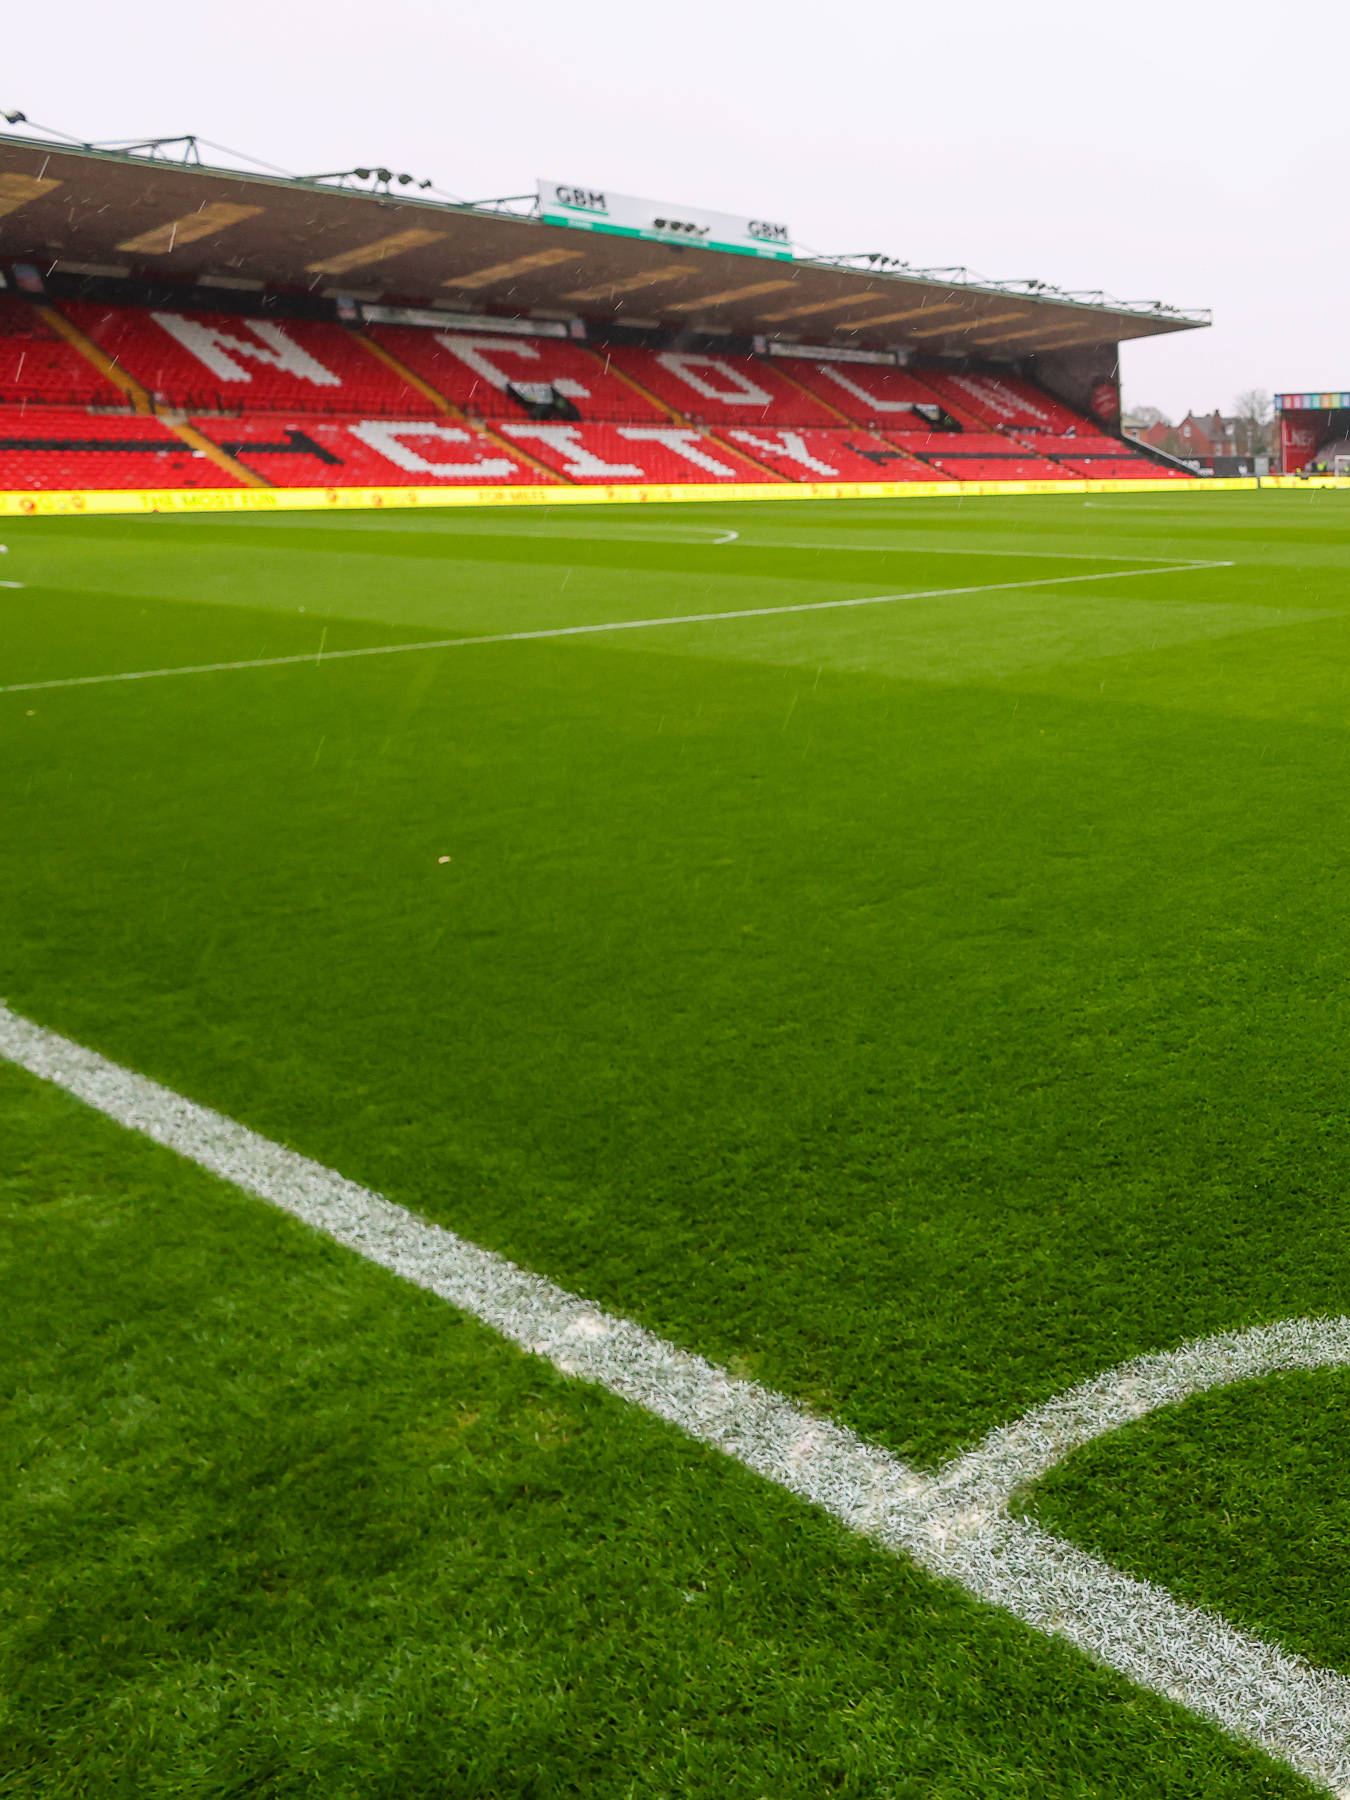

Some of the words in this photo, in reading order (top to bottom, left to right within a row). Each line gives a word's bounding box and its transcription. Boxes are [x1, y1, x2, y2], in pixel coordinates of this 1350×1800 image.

[555, 186, 606, 209] GBM
[748, 220, 788, 239] GBM
[348, 419, 840, 479] CITY
